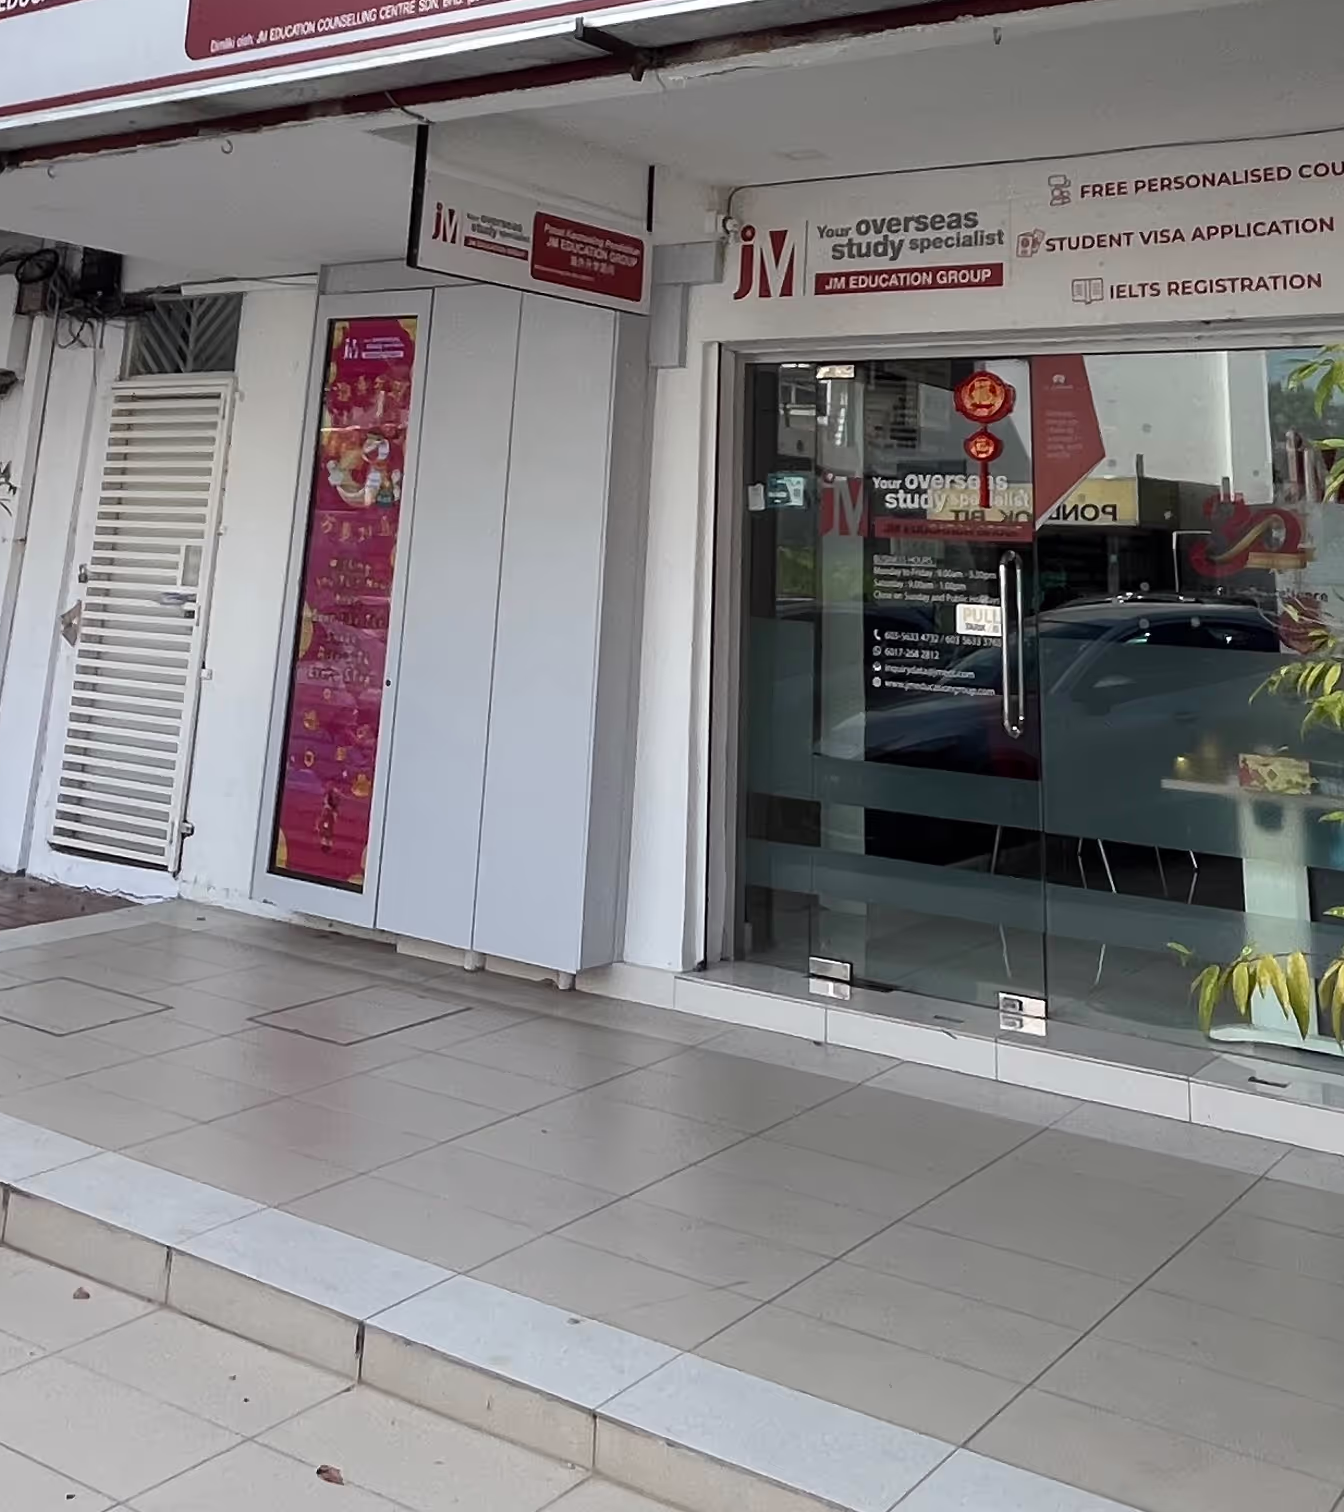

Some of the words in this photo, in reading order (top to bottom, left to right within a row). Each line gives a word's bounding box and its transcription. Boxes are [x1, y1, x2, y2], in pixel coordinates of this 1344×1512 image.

[269, 19, 317, 42] EDUCATION
[317, 6, 378, 32] COUNSELLING
[379, 0, 416, 22] CENTRE
[1079, 182, 1129, 200] FREE
[1134, 165, 1293, 195] PERSONALISED
[817, 224, 852, 240] Your
[855, 210, 979, 237] overseas
[1045, 232, 1135, 253] STUDENT
[1139, 228, 1186, 246] VISA
[1191, 216, 1336, 242] APPLICATION
[831, 236, 904, 262] study
[908, 230, 1005, 254] specialist
[825, 276, 847, 291] JM
[849, 271, 933, 290] EDUCATION
[936, 267, 993, 286] GROUP
[1109, 282, 1162, 300] IELTS
[1167, 272, 1323, 297] REGISTRATION
[872, 476, 902, 490] Your
[904, 473, 1008, 490] overses
[884, 490, 945, 513] study
[904, 592, 930, 603] Sunday
[931, 593, 945, 602] and
[946, 593, 969, 602] Public
[963, 607, 1002, 623] PULL
[920, 633, 939, 644] 4732
[921, 649, 940, 660] 2812
